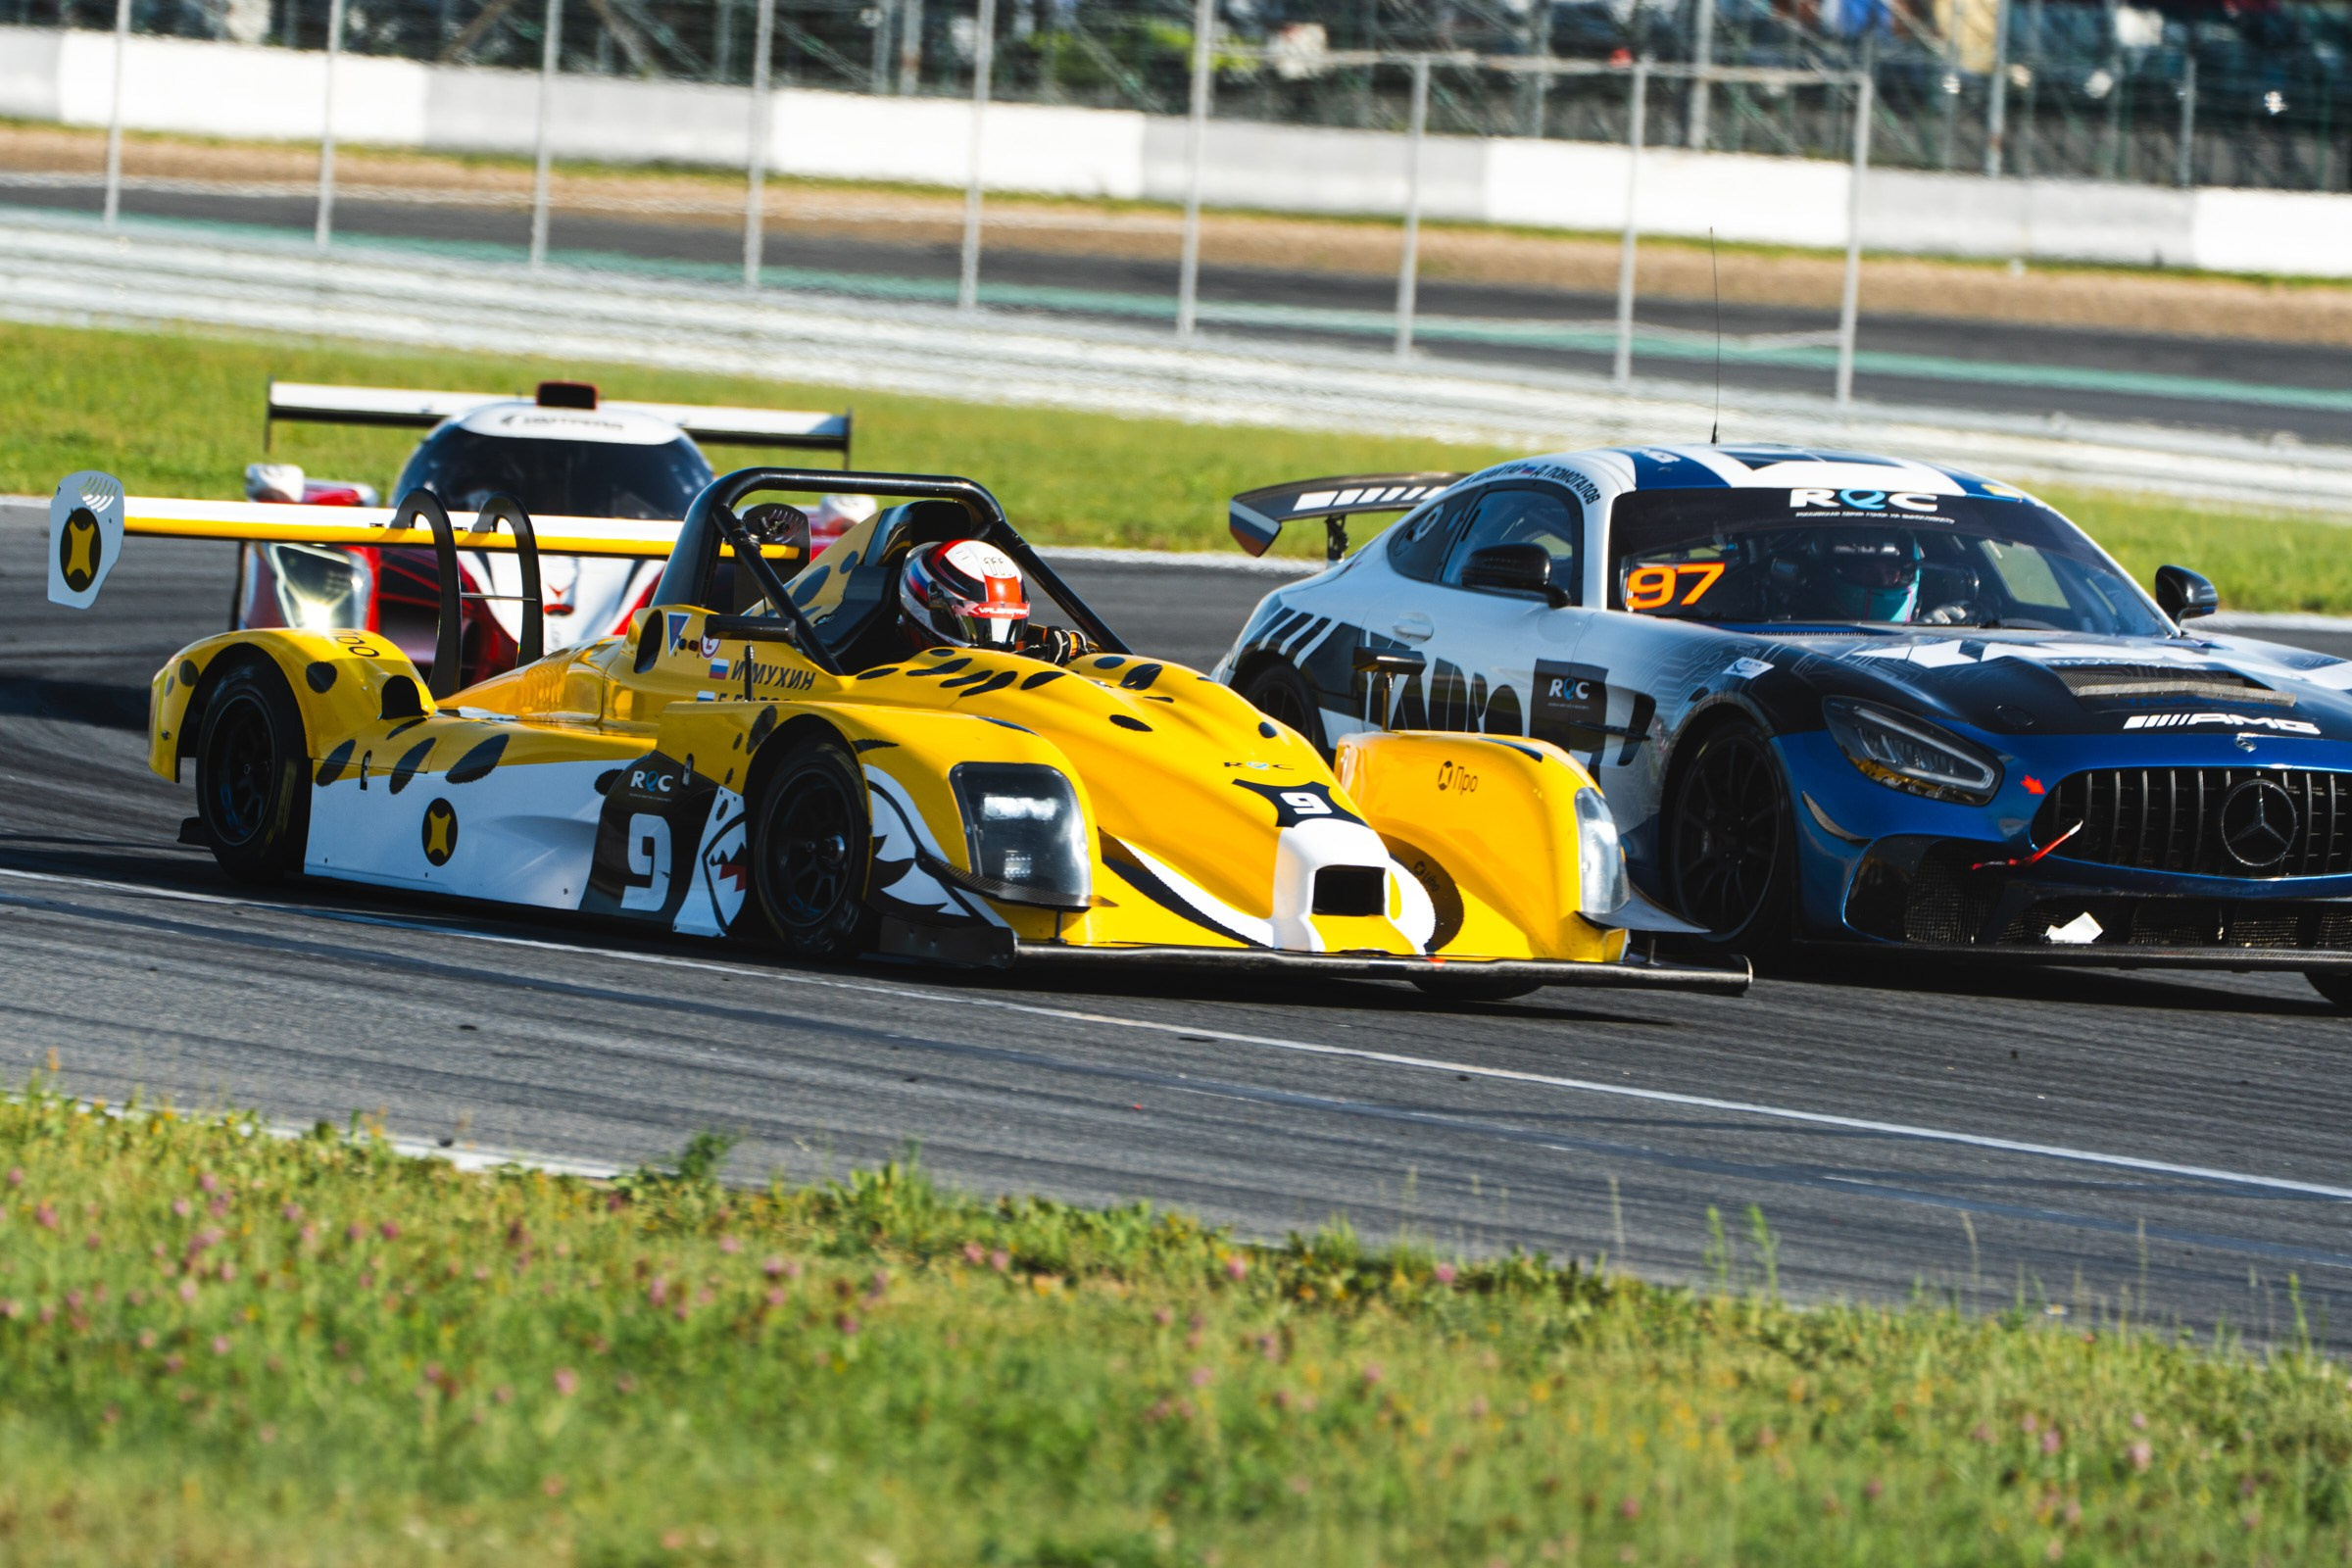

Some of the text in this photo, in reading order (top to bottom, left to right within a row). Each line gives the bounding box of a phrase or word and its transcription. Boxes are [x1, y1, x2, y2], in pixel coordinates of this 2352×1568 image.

[1626, 562, 1726, 610] 97
[2186, 712, 2322, 735] AMG
[1279, 792, 1333, 815] 9
[619, 812, 672, 912] 9
